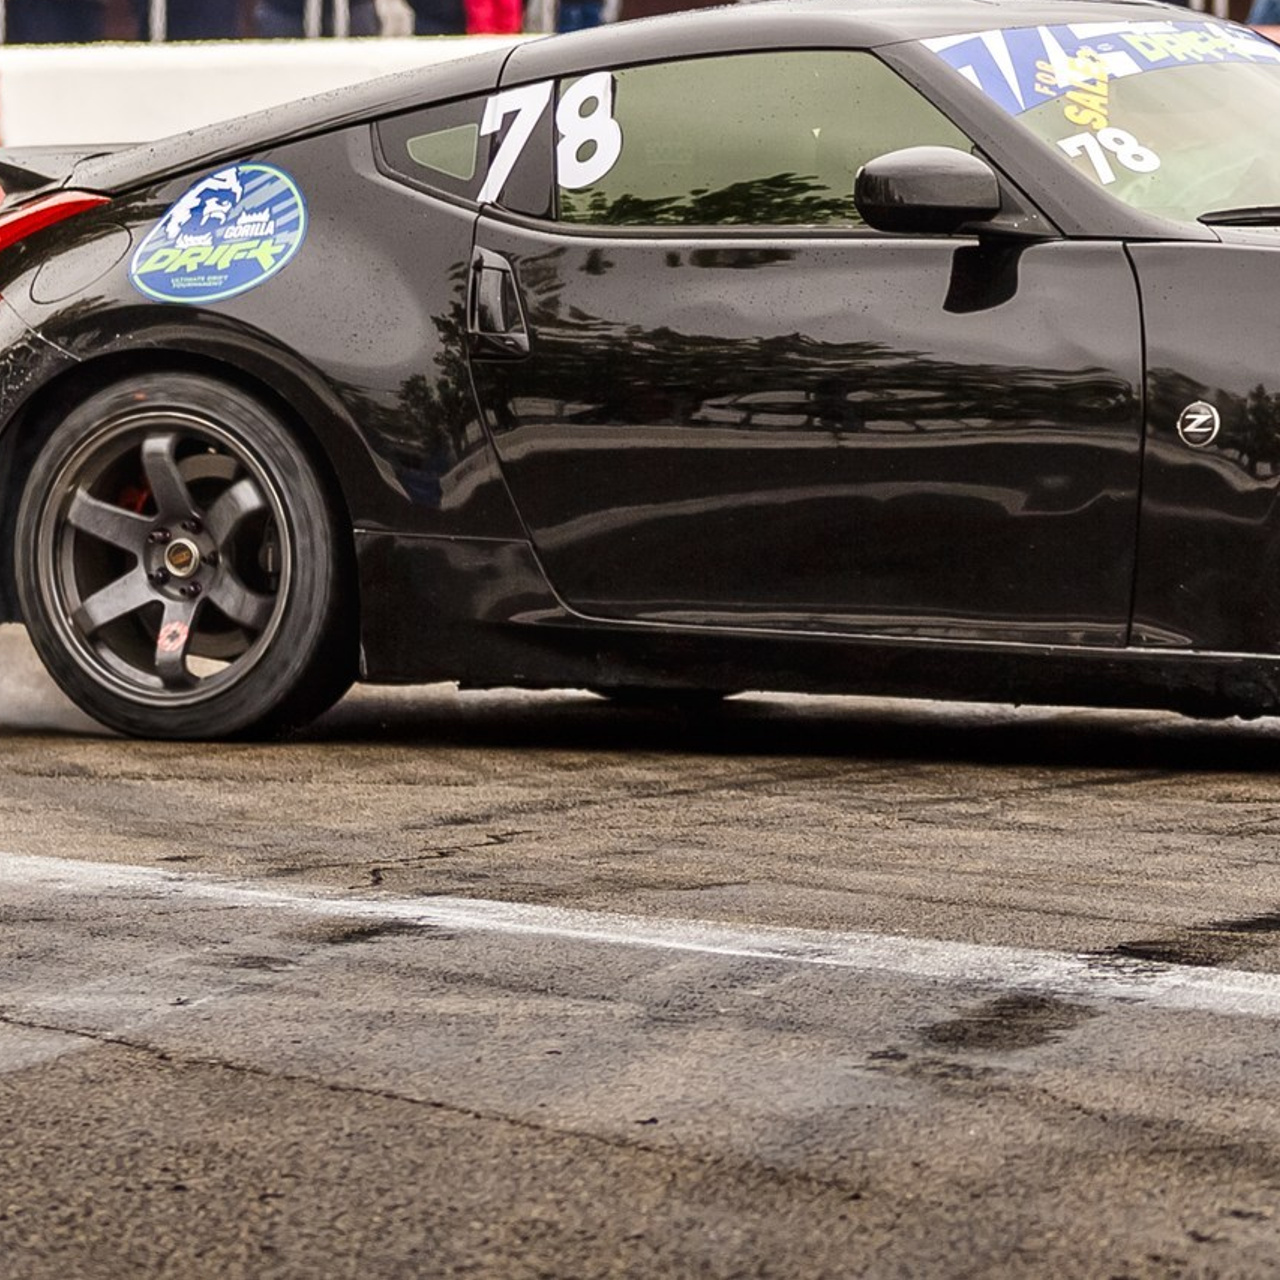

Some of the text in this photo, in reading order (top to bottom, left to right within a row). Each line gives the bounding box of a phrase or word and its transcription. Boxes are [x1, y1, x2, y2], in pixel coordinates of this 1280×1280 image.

[476, 71, 623, 203] 78
[1056, 126, 1161, 185] 78
[223, 220, 275, 240] GORILLA
[135, 239, 286, 274] DRIFT
